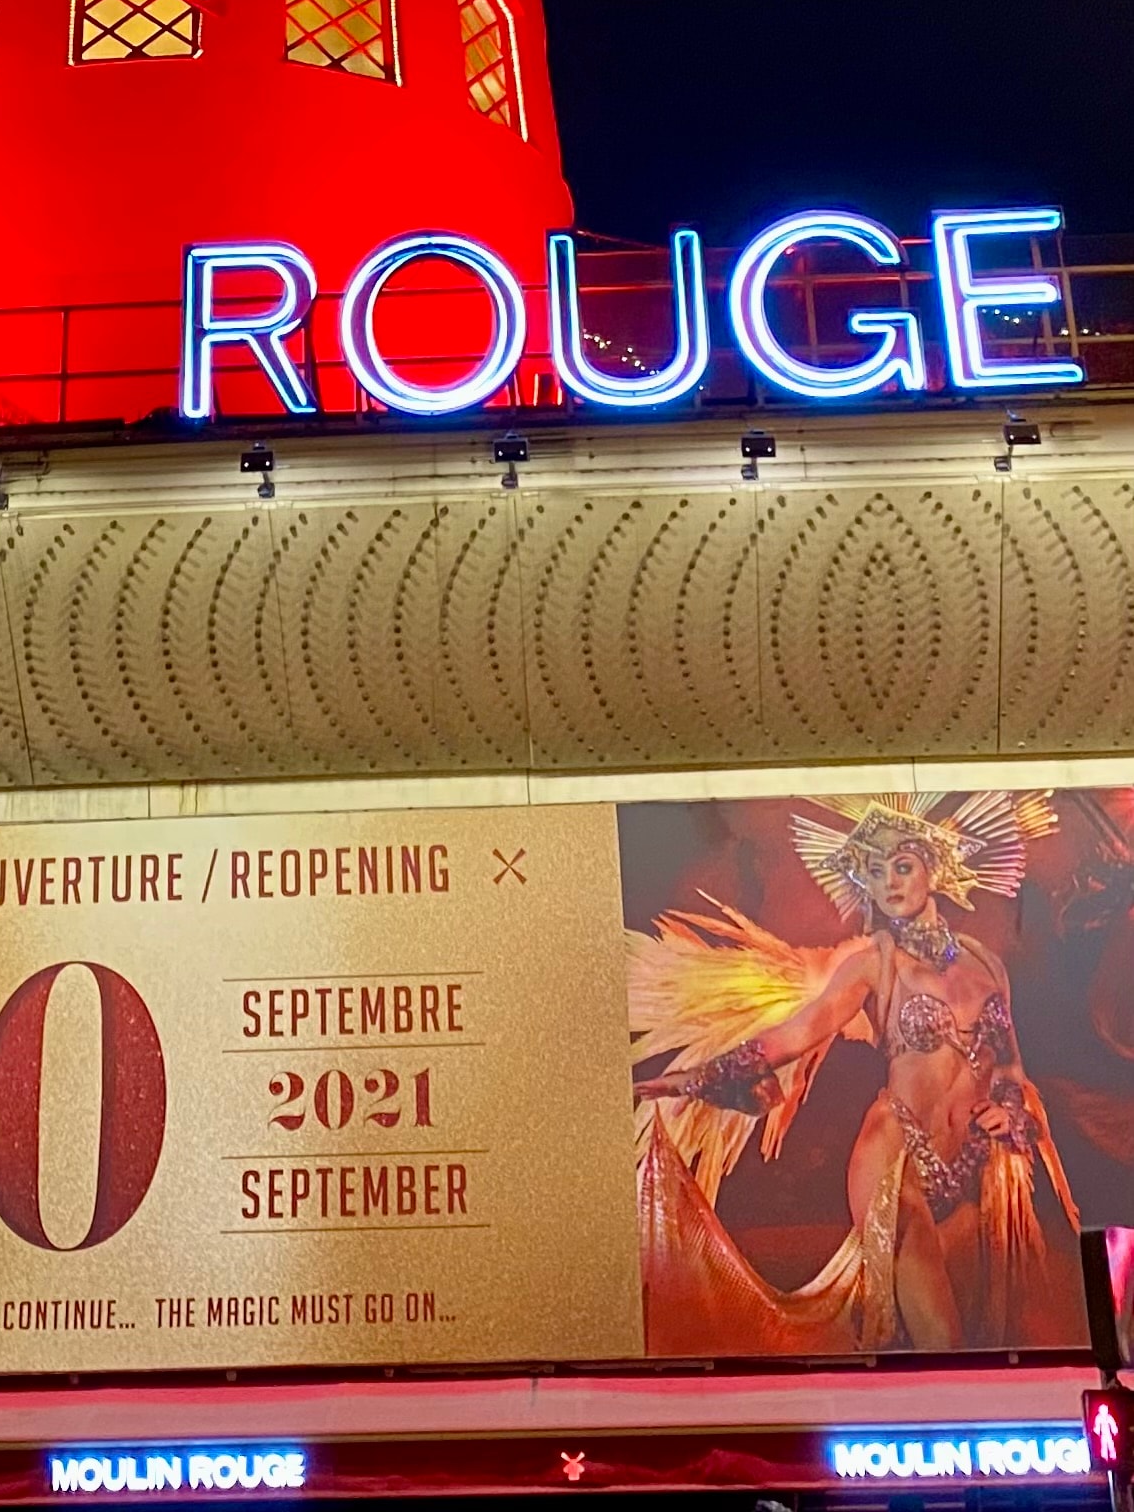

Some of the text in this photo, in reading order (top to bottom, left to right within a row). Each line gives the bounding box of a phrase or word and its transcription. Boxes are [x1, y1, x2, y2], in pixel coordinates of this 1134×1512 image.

[180, 204, 1086, 419] ROUGE
[231, 844, 450, 899] REOPENING
[242, 983, 465, 1038] SEPTEMBRE
[268, 1066, 435, 1132] 2021
[241, 1163, 468, 1220] SEPTEMBER
[155, 1298, 196, 1328] THE
[207, 1296, 280, 1327] MAGIC
[291, 1294, 353, 1325] MUST
[366, 1293, 394, 1324] GO
[52, 1453, 306, 1492] MOULIN ROUGE
[834, 1441, 973, 1478] MOULIN
